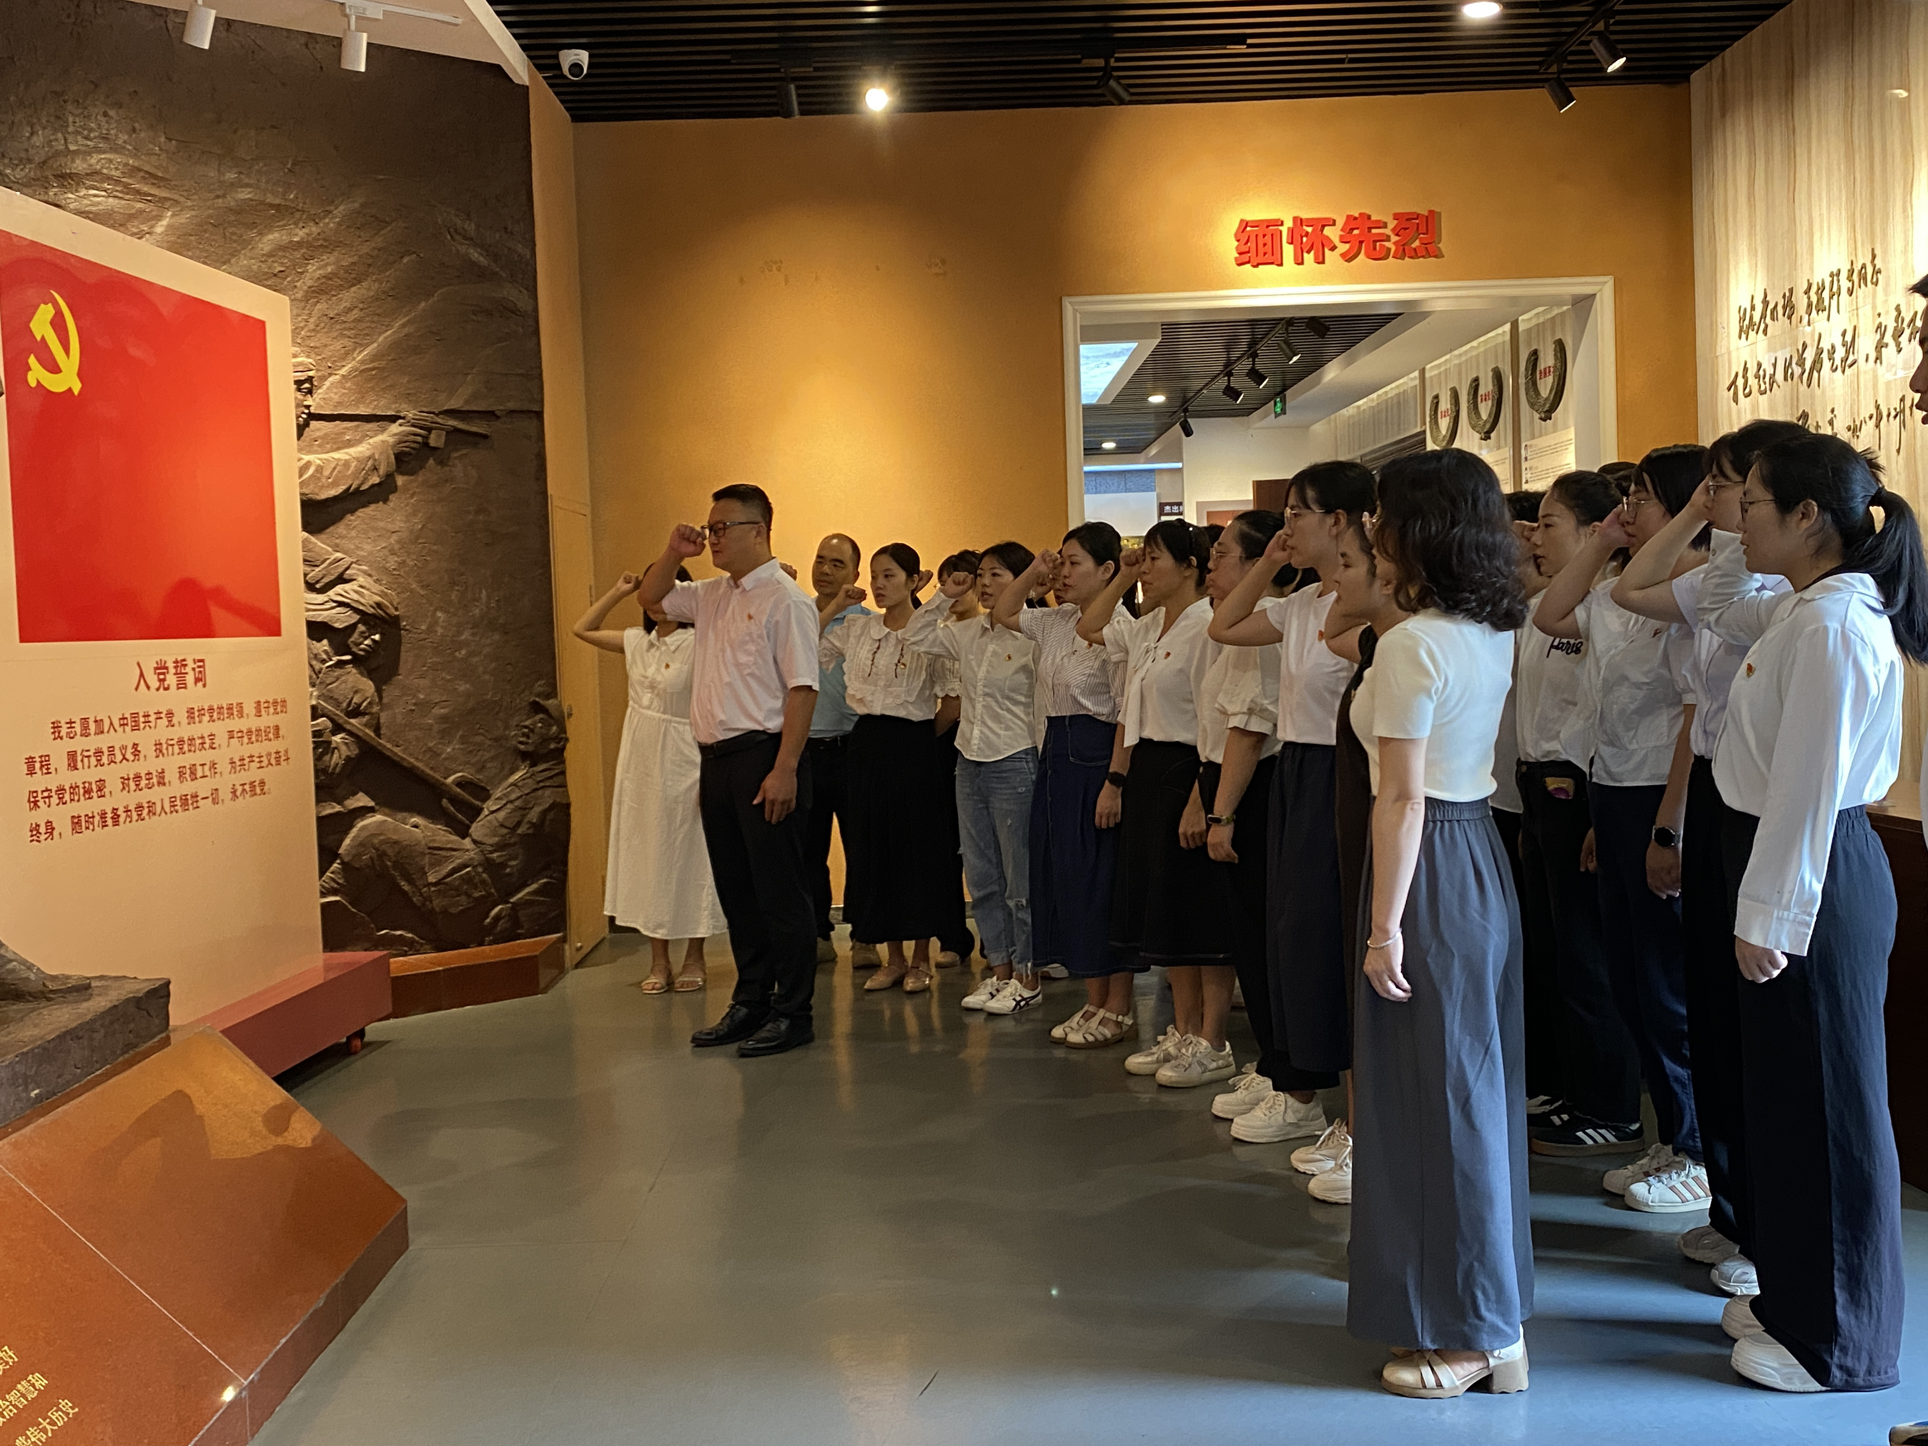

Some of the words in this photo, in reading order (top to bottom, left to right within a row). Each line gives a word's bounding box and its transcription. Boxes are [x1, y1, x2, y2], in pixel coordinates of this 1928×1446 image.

[1234, 209, 1440, 267] 缅怀先烈
[134, 658, 207, 692] 入党誓词
[50, 697, 288, 741] 我志愿加入中国共产党，拥护党的纲领，遵守党的
[0, 1372, 48, 1426] 治智慧和
